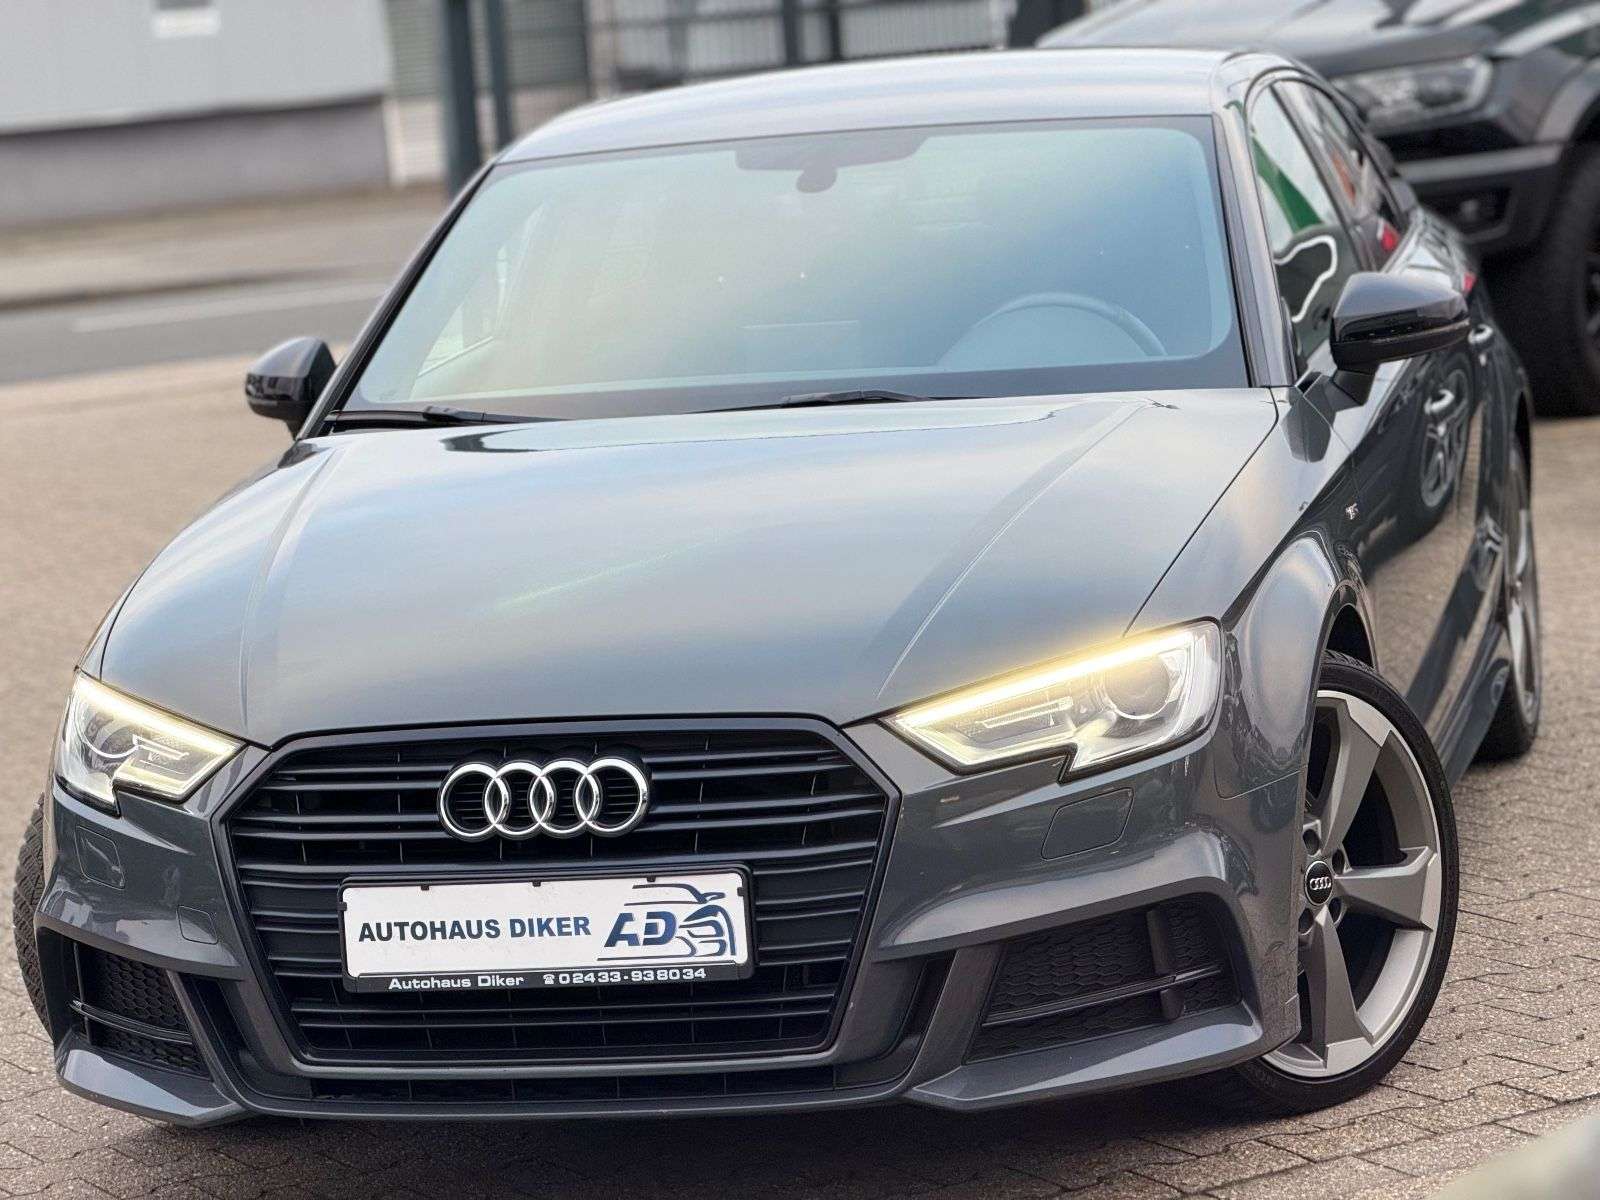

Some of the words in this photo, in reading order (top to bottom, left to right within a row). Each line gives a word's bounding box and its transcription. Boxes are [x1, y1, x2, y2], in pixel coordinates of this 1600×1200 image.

[358, 919, 501, 942] AUTOHAUS
[509, 916, 592, 938] DIKER
[603, 911, 677, 948] AD
[388, 975, 472, 990] Autohaus
[477, 974, 525, 987] Diker
[558, 968, 707, 985] 02433-938034
